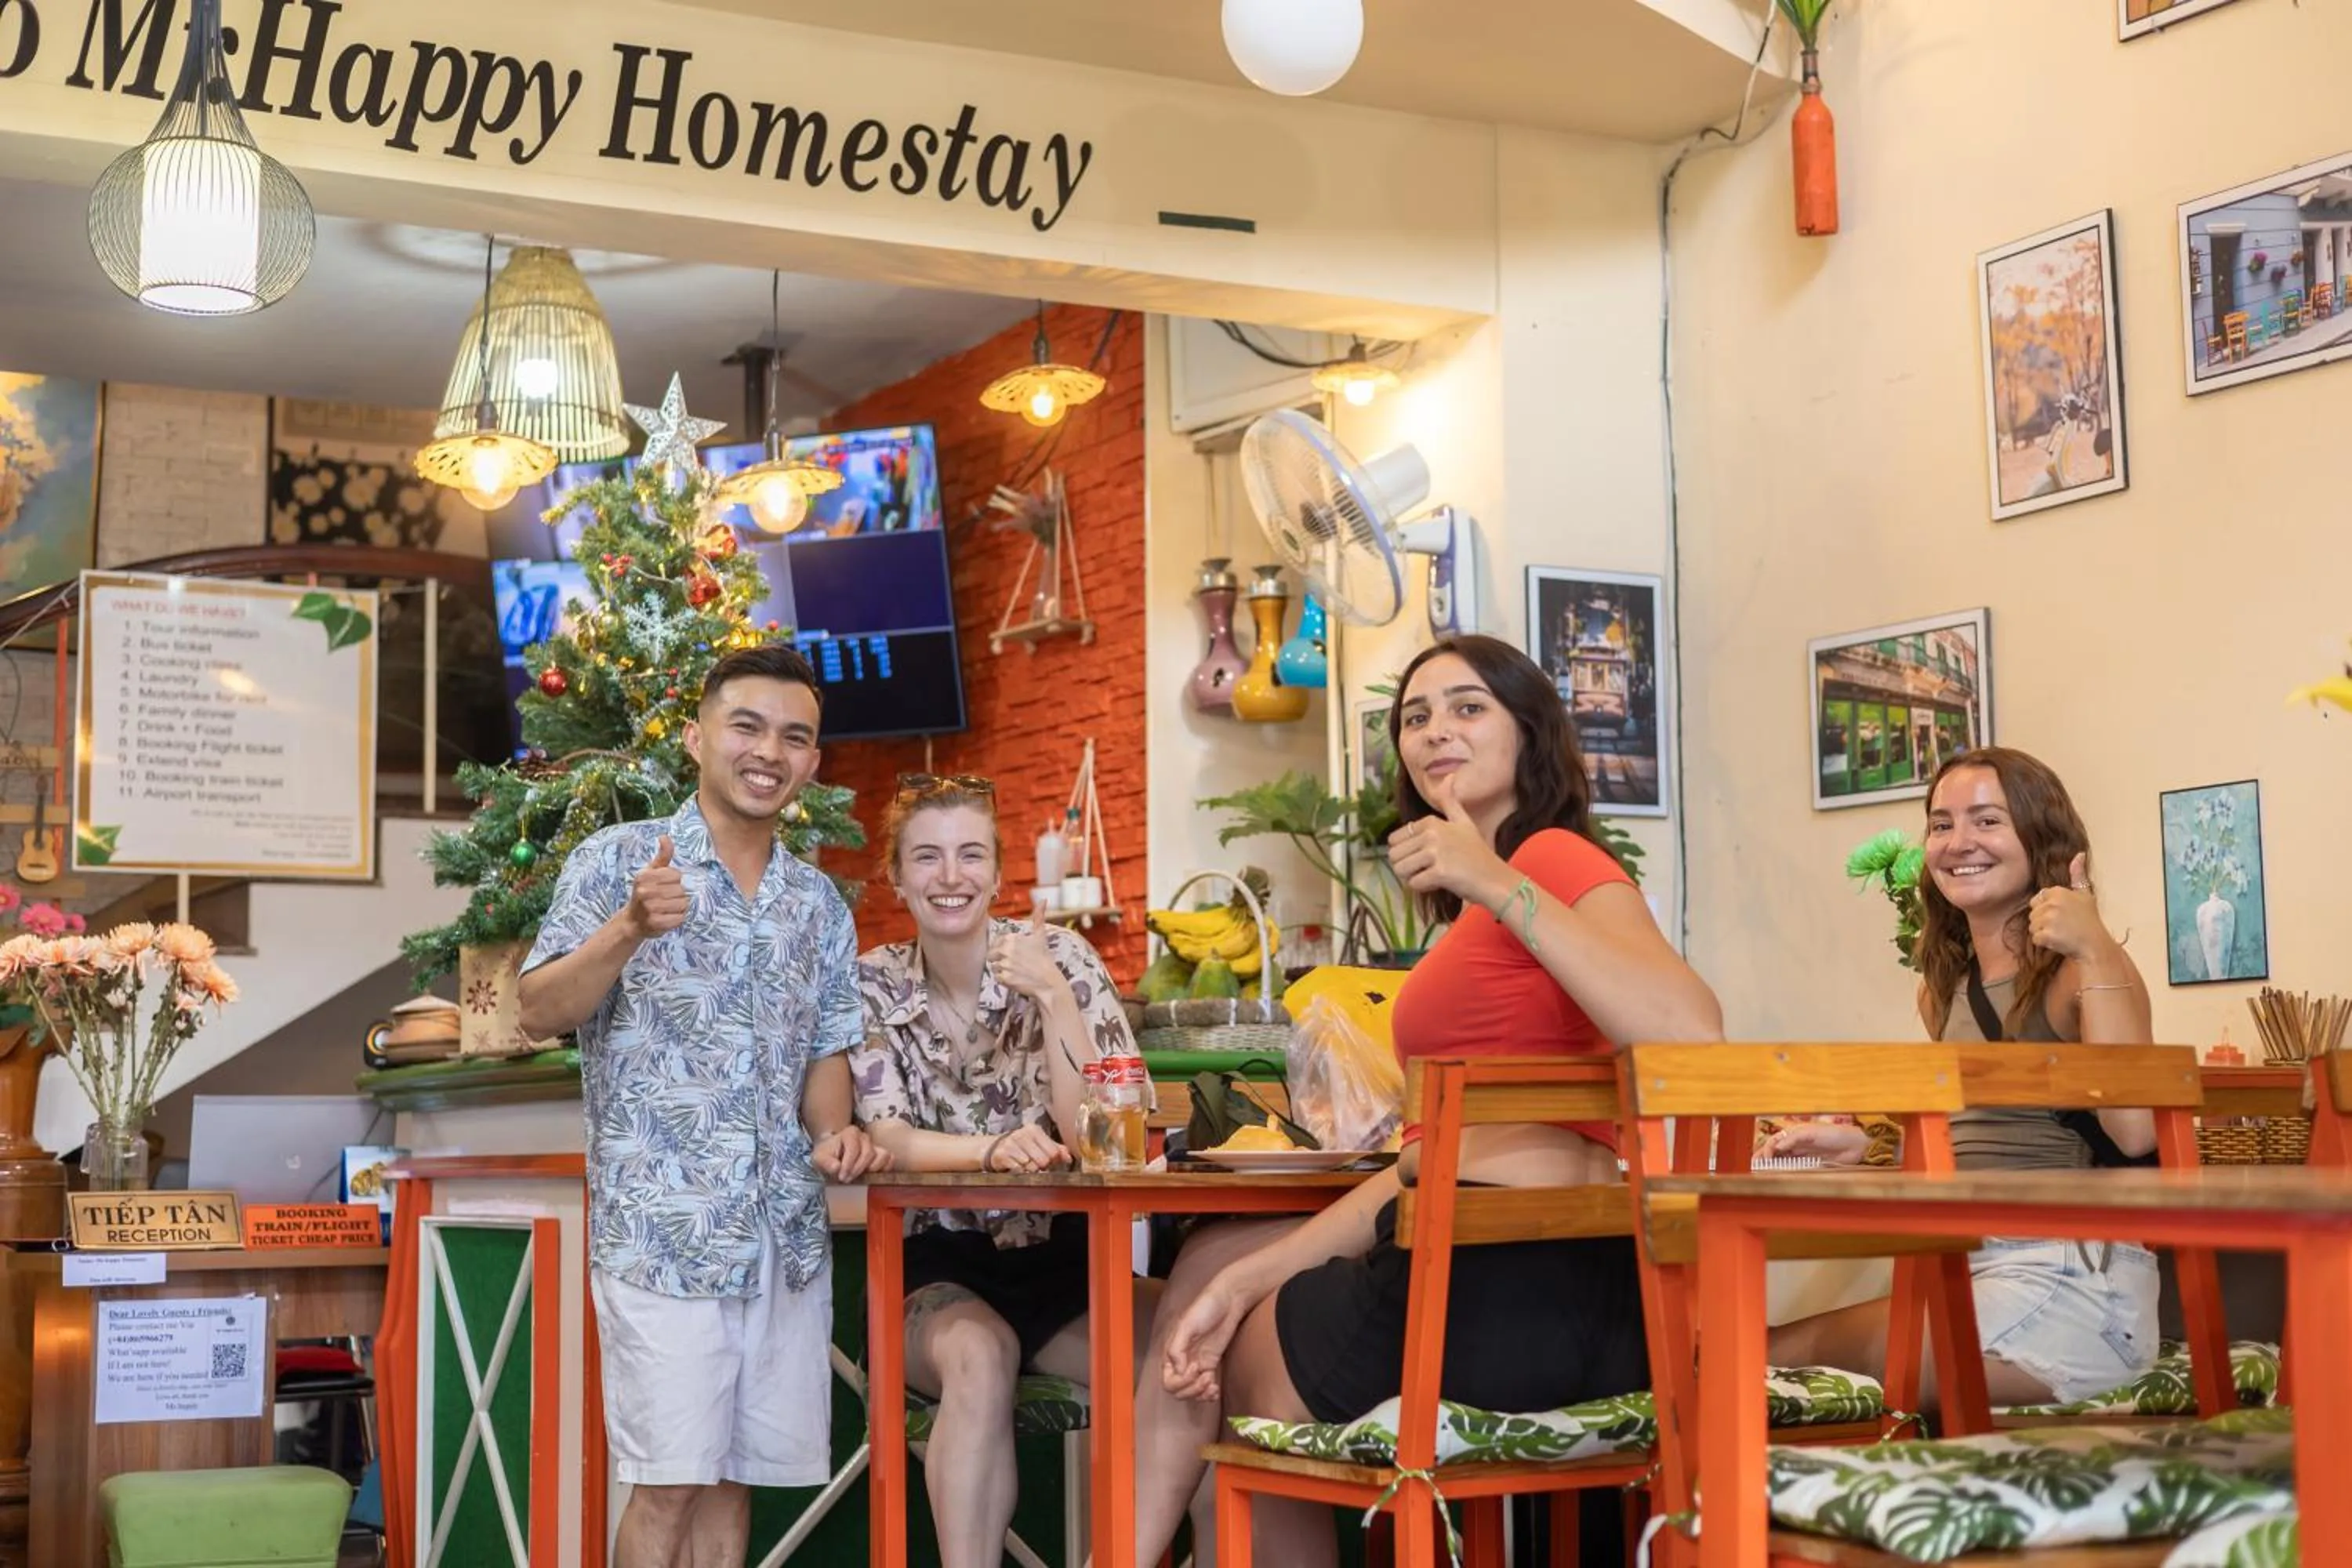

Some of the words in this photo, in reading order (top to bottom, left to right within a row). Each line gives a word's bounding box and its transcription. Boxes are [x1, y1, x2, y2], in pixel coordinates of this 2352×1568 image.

[599, 42, 1093, 231] Homestay
[111, 600, 151, 613] WHAT
[179, 604, 200, 616] WE
[142, 620, 174, 633] Tour
[179, 623, 260, 639] information
[140, 637, 169, 650] Bus
[173, 640, 213, 653] ticket
[140, 654, 200, 670] Cooking
[140, 671, 199, 686] Laundry
[139, 687, 211, 701] Motorbike
[215, 691, 234, 702] for
[138, 703, 187, 720] Family
[191, 707, 238, 720] dinner
[137, 719, 176, 733] Drink
[194, 723, 234, 736] Food
[136, 737, 197, 753] Booking
[245, 743, 284, 755] ticket
[136, 753, 189, 768] Extend
[193, 758, 222, 768] visa
[145, 770, 205, 786] Booking
[245, 775, 284, 788] ticket
[143, 786, 192, 801] Airport
[197, 789, 261, 804] transport
[82, 1197, 156, 1226] TIẾP
[165, 1200, 227, 1225] TÂN
[276, 1208, 348, 1218] BOOKING
[254, 1220, 371, 1232] TRAIN/FLIGHT
[107, 1228, 212, 1243] RECEPTION
[251, 1235, 294, 1246] TICKET
[298, 1235, 337, 1245] CHEAP
[341, 1234, 375, 1243] PRICE
[109, 1309, 129, 1319] Dear
